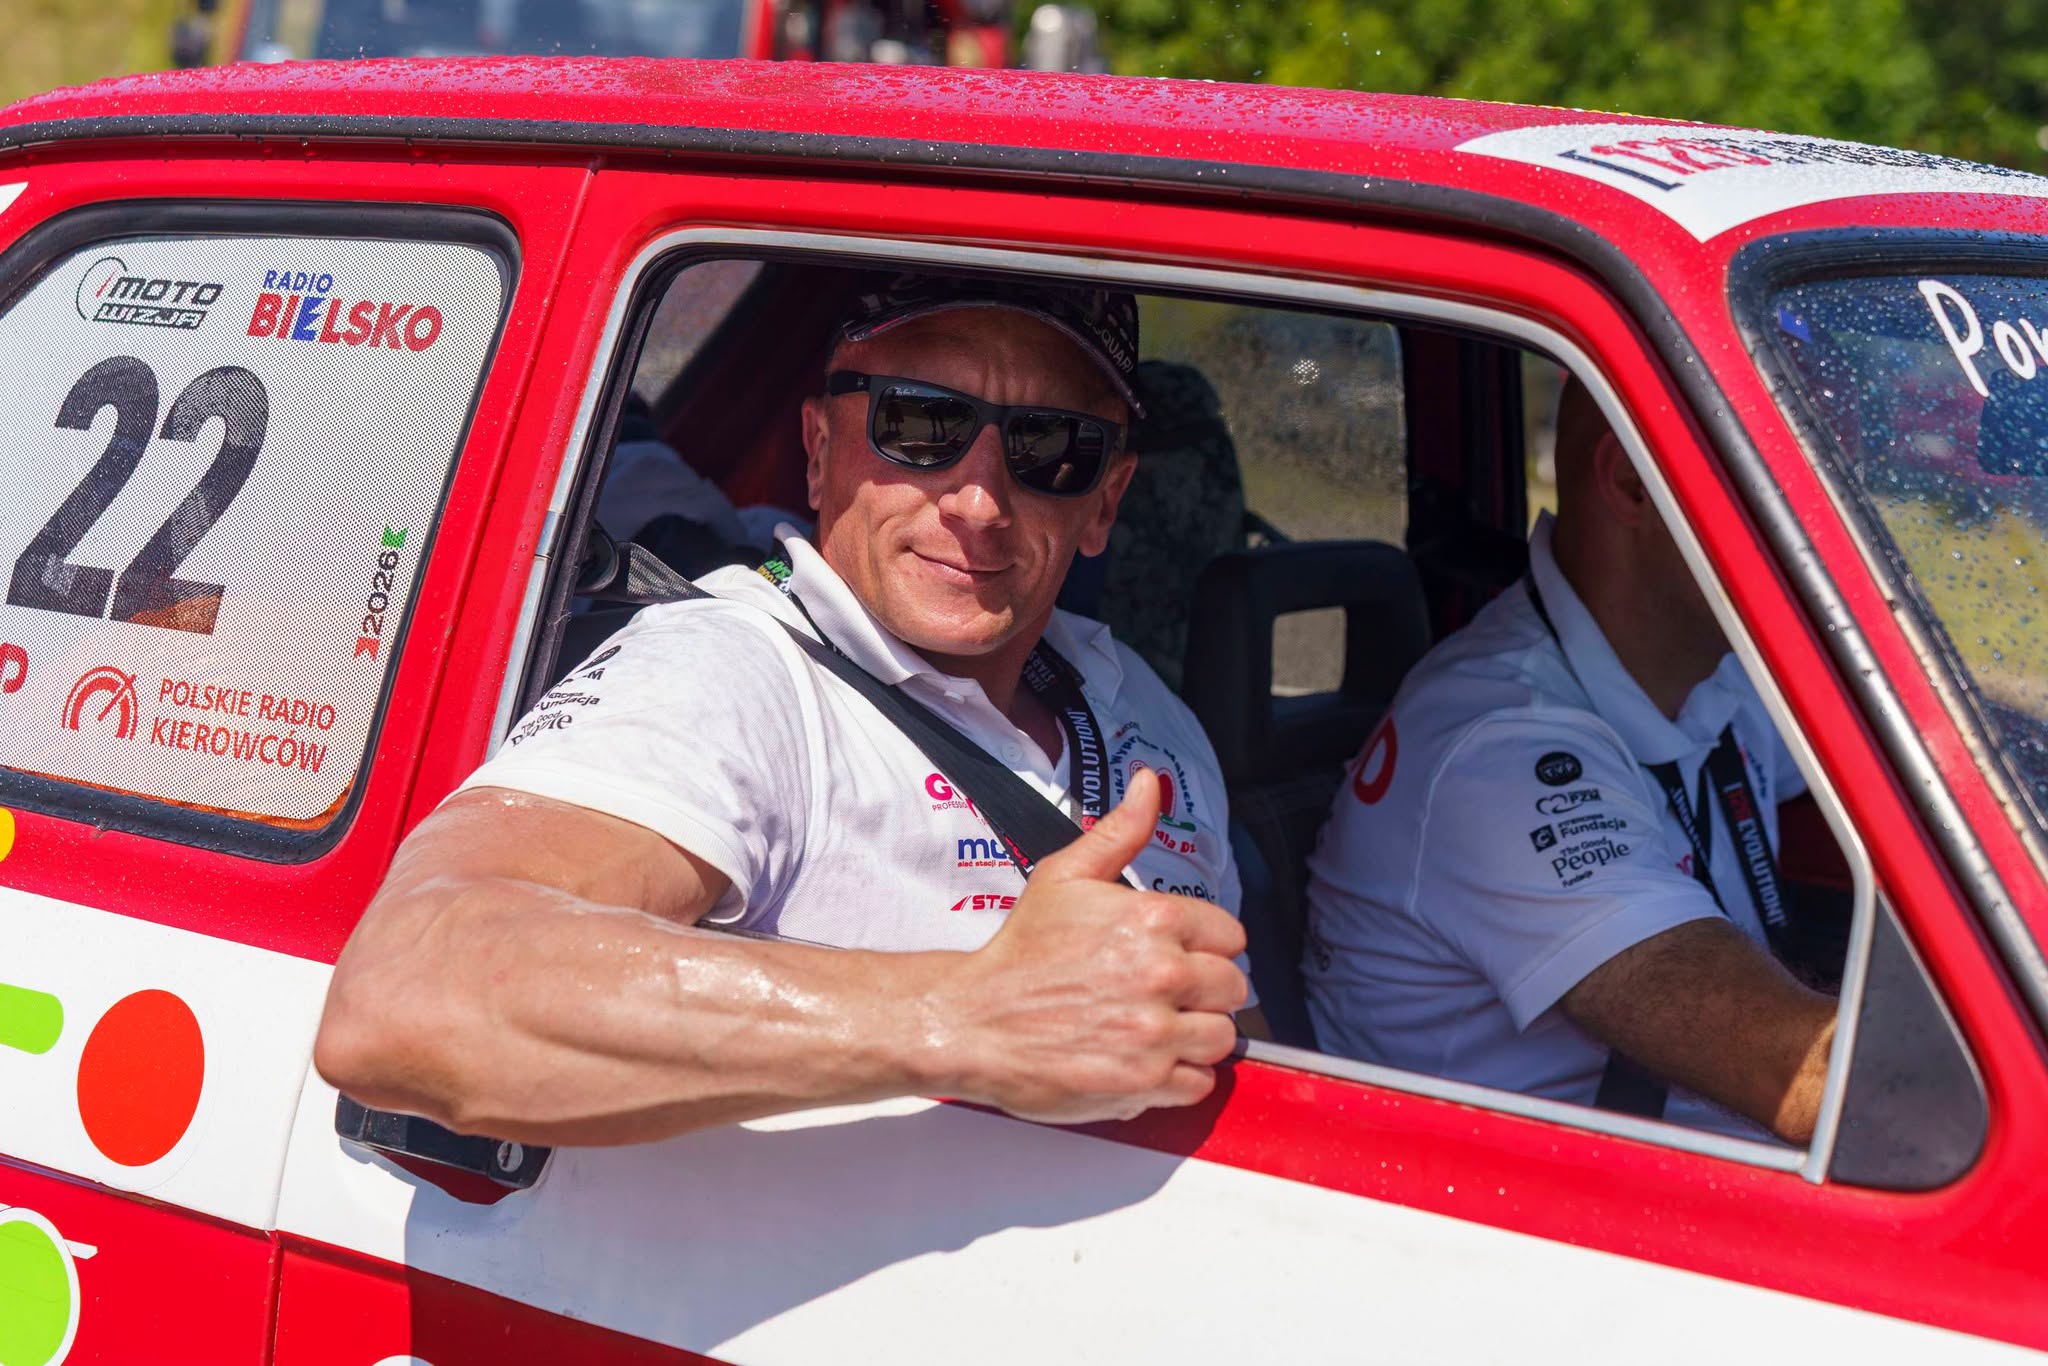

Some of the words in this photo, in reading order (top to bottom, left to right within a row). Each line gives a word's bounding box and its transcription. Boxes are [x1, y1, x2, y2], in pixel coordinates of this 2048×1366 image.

[262, 269, 334, 293] RADIO
[96, 304, 205, 329] WIZJA
[246, 292, 444, 353] BIELSKO
[7, 355, 270, 635] 22
[362, 550, 400, 637] 2026
[159, 677, 253, 717] POLSKIE
[259, 695, 336, 731] RADIO
[535, 695, 601, 711] undacja
[150, 717, 329, 773] KIEROWCÓW
[1560, 818, 1627, 838] Fundacja
[1552, 840, 1631, 878] People
[1560, 845, 1580, 856] The
[1580, 836, 1609, 850] Good
[972, 895, 1018, 911] STS
